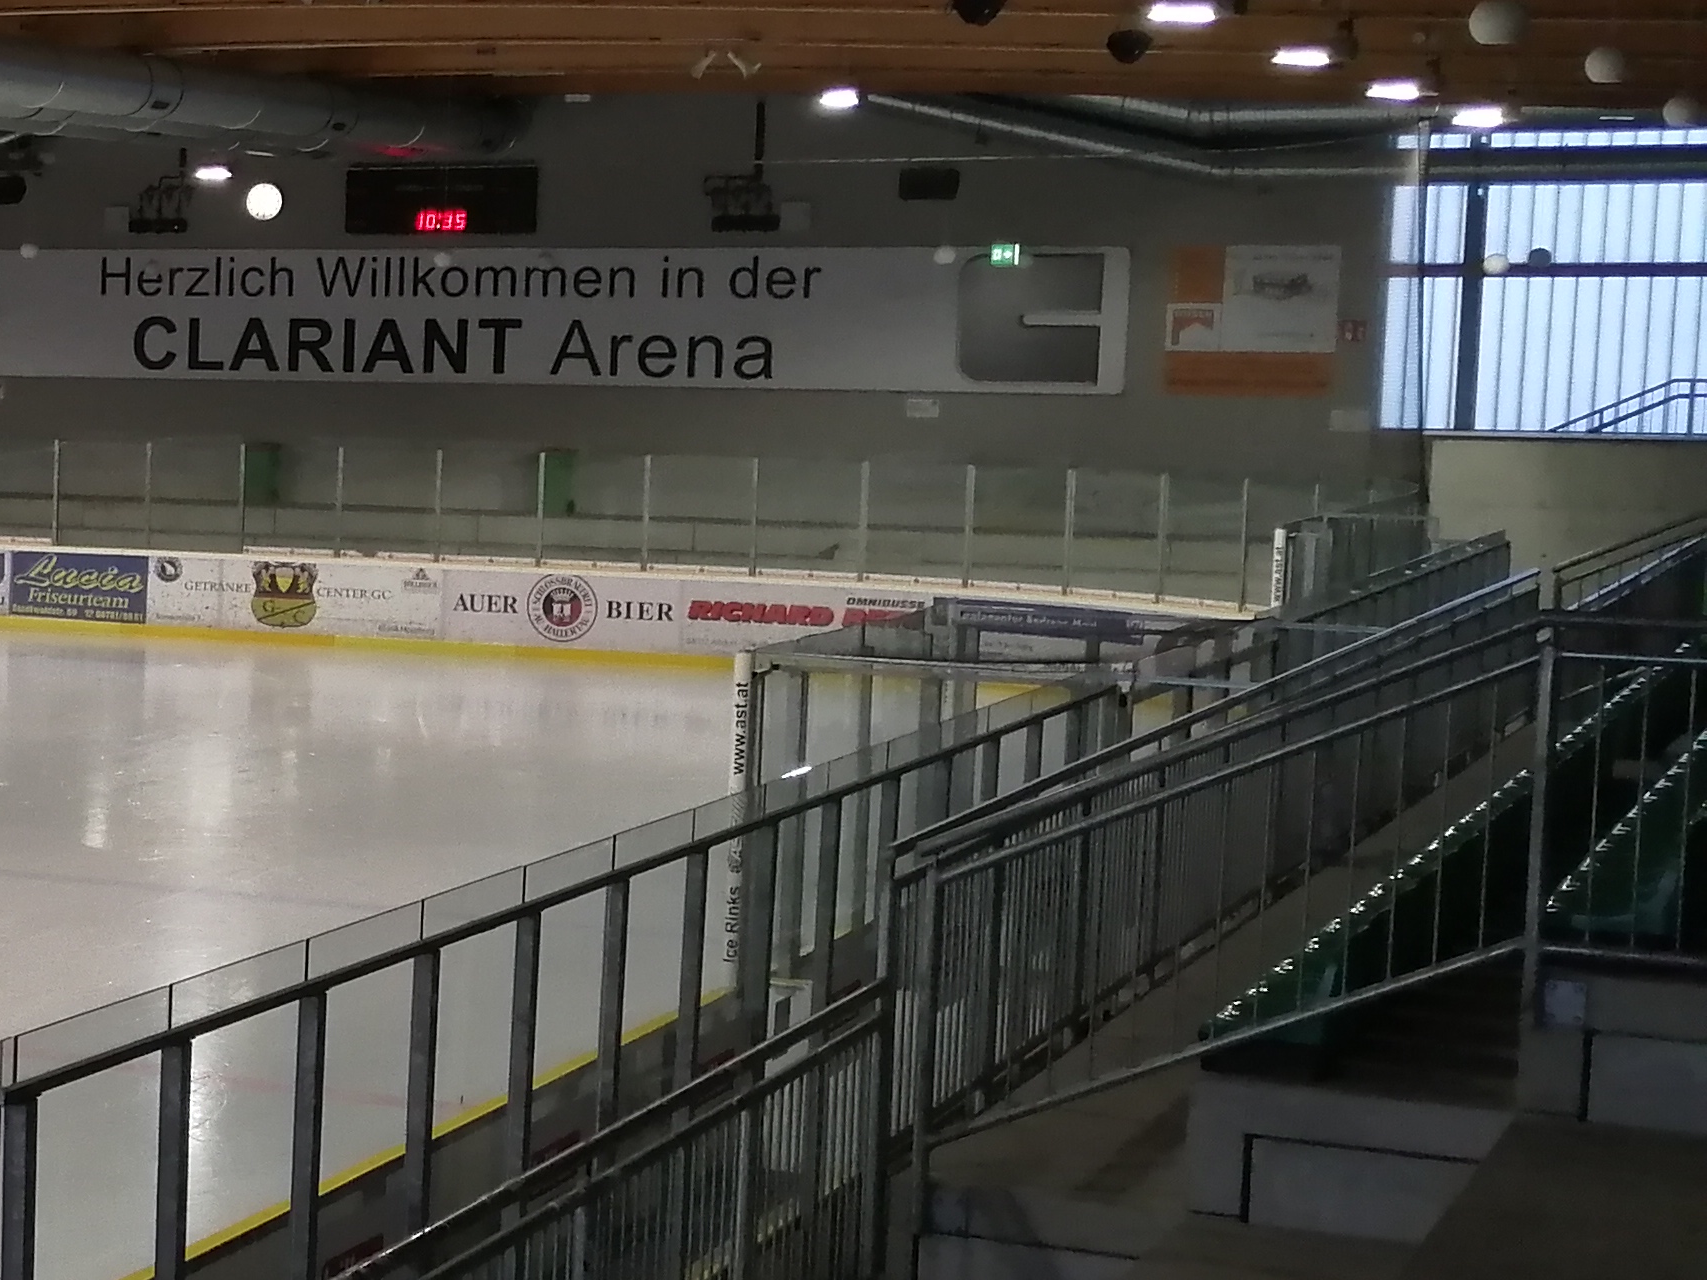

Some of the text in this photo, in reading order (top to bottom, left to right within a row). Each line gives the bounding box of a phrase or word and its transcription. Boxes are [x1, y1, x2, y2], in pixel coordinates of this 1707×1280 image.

[100, 255, 821, 300] Herzlich Willkommen in der
[132, 316, 775, 381] CLARIANT Arena
[13, 552, 144, 594] Lucia
[316, 585, 369, 600] CENTER
[26, 586, 130, 609] Friseurteam
[452, 592, 674, 622] AUER BIER
[733, 681, 749, 777] www.ast.at
[722, 885, 741, 964] Ice Rinks
